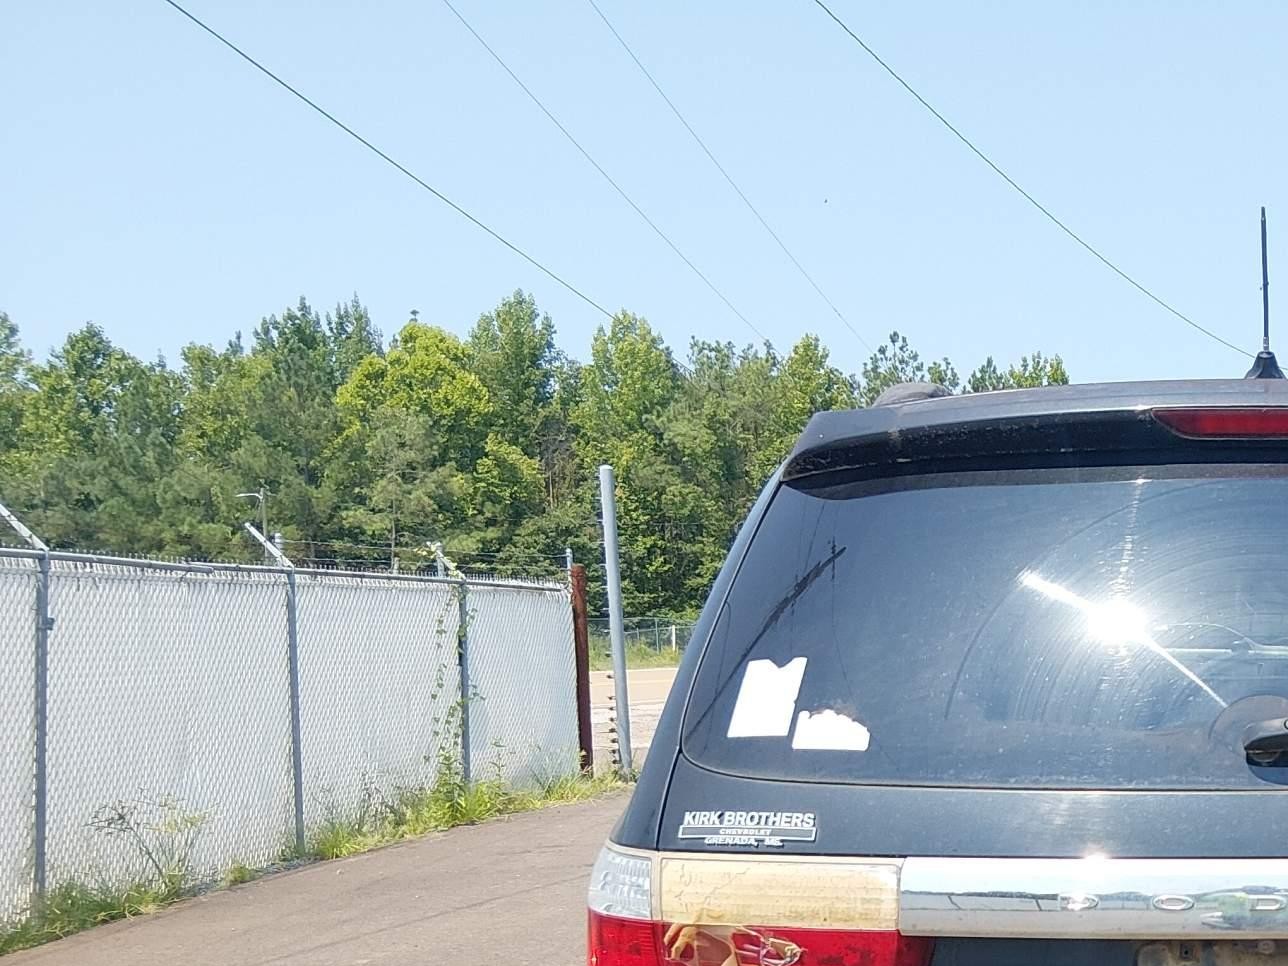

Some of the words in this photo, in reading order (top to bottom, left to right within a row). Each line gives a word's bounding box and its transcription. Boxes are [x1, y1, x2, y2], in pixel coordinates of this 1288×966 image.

[684, 811, 722, 826] KIRK
[723, 811, 816, 828] BROTHERS
[704, 836, 760, 848] GRENADA,
